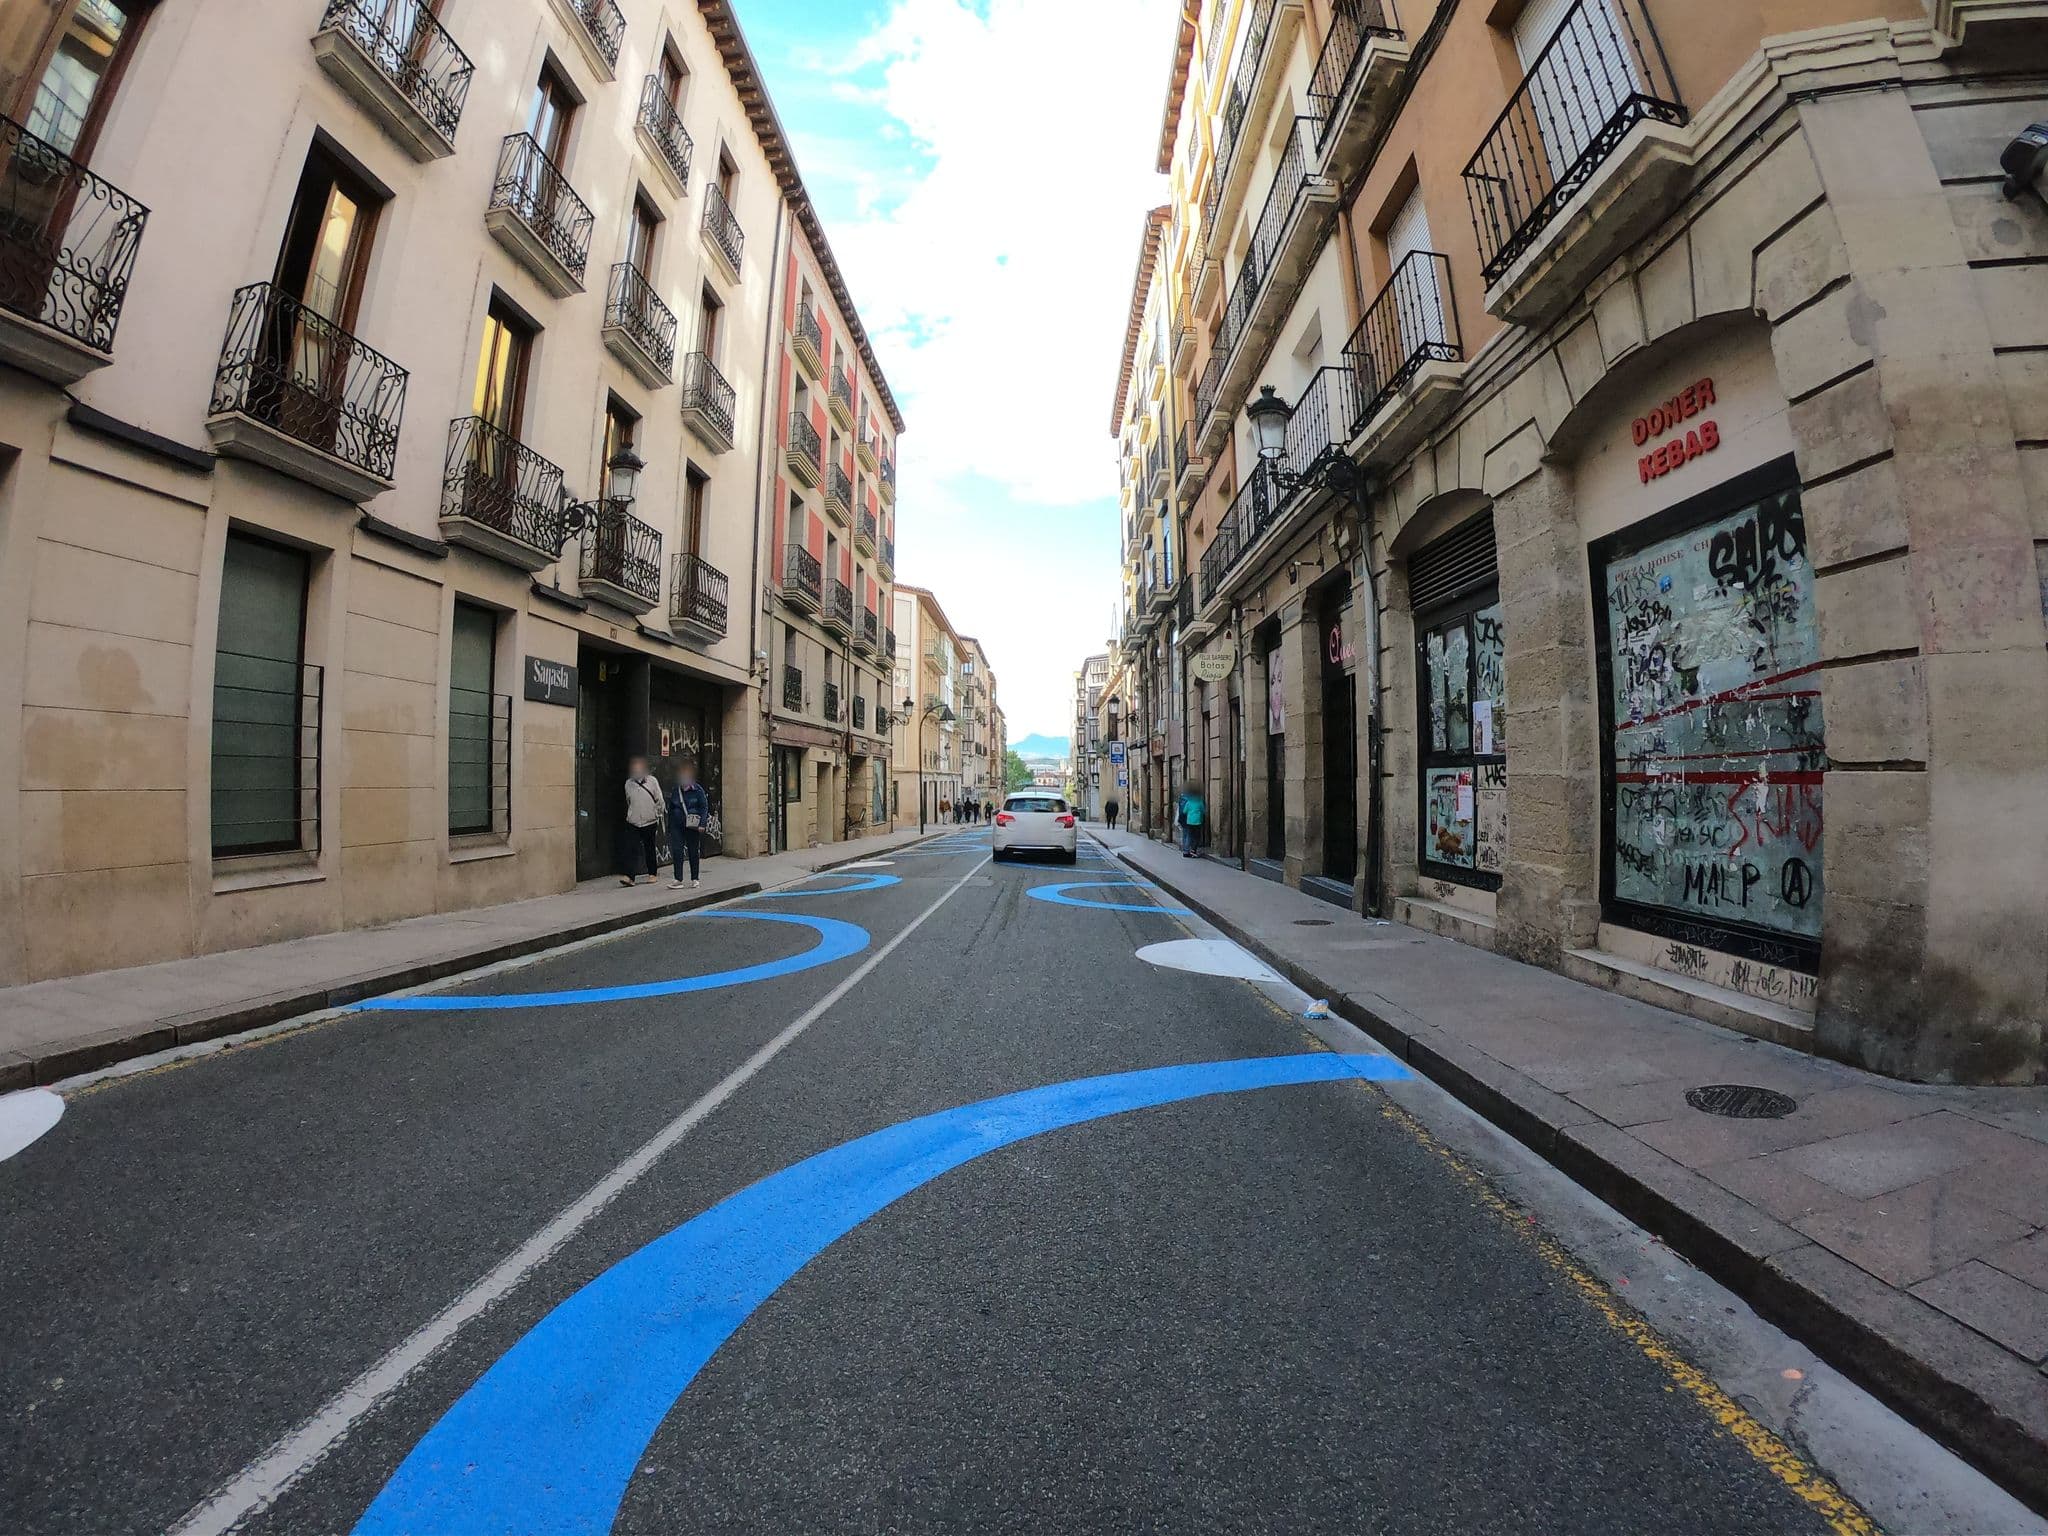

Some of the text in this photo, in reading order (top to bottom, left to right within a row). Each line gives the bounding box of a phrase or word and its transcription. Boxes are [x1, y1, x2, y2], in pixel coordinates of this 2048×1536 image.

[1637, 420, 1720, 484] KEBAB
[1648, 549, 1684, 570] HOUSE
[533, 659, 569, 699] Sagasta
[1200, 660, 1225, 669] Botas
